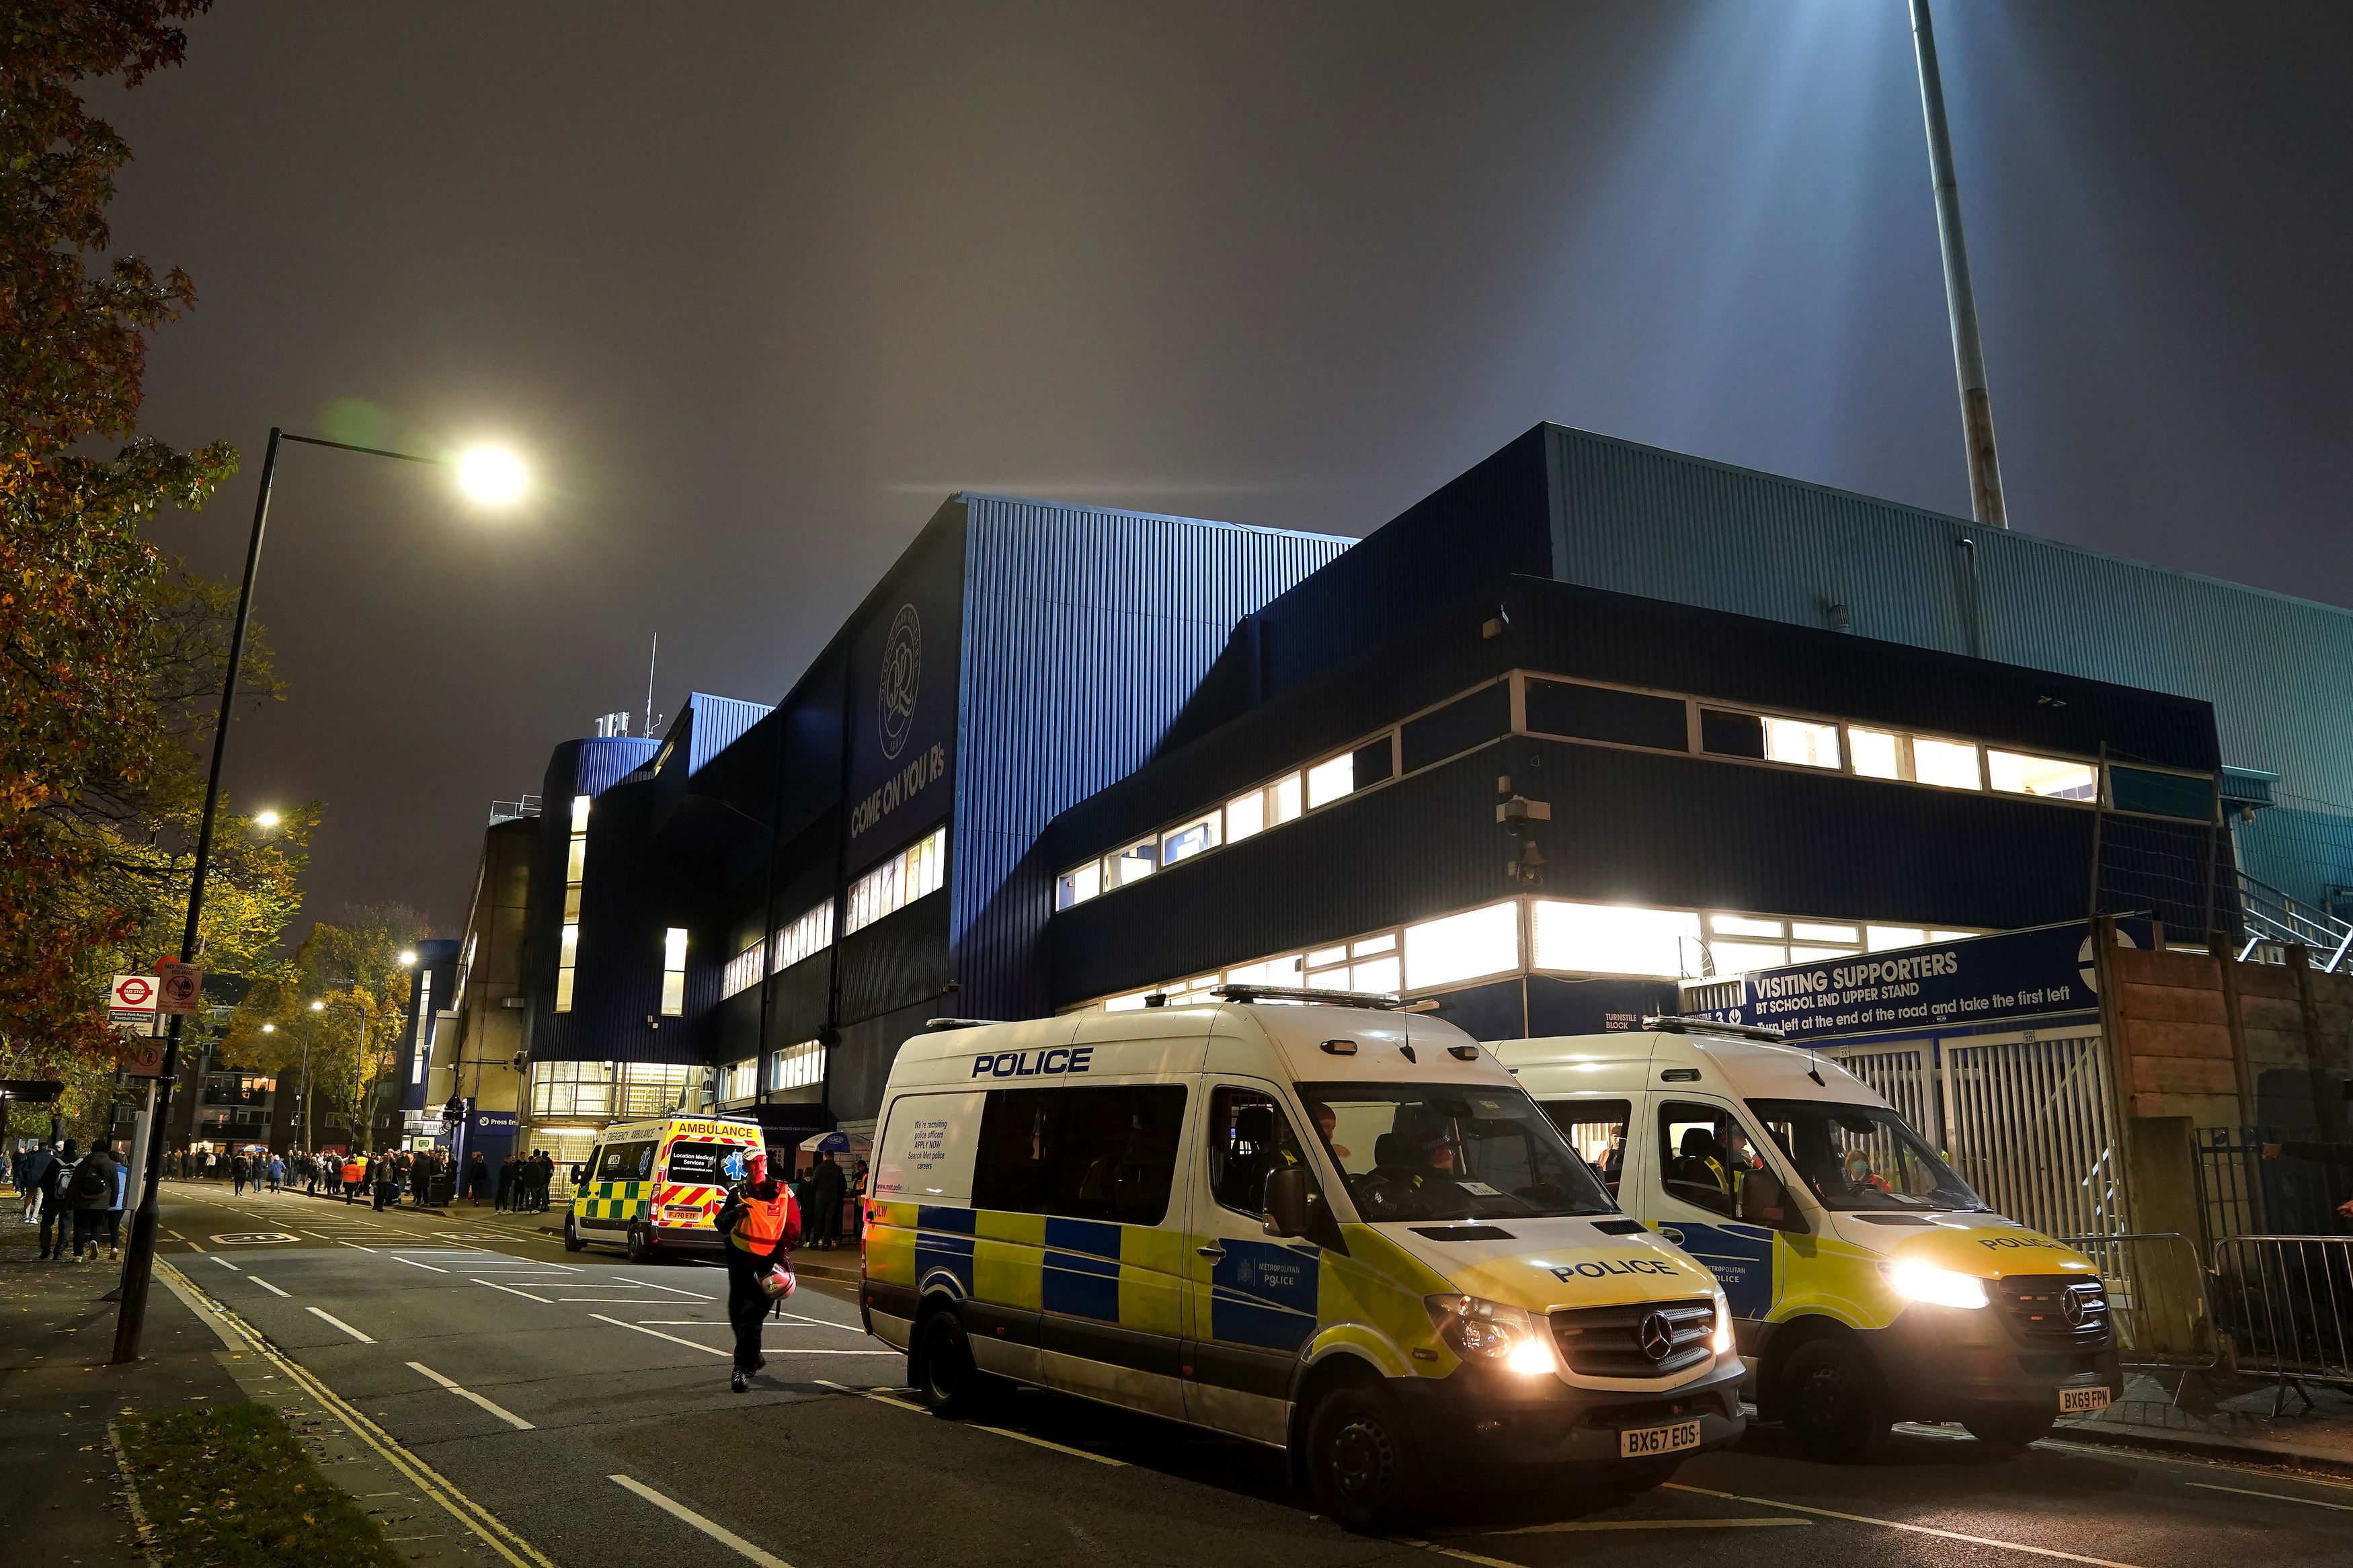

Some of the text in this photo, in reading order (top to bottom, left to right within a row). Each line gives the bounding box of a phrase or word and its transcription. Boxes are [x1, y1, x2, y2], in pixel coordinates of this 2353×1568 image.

[851, 787, 881, 839] COME
[883, 772, 901, 815] ON
[903, 751, 927, 801] YOU
[1754, 951, 1958, 999] VISITING SUPPORTERS
[1755, 982, 1919, 1015] BT SCHOOL END UPPER STAND
[1782, 1018, 1799, 1031] left
[1801, 1017, 1814, 1030] at
[1815, 1015, 1833, 1028] the
[1836, 1011, 1858, 1026] end
[1861, 1009, 1874, 1022] of
[1875, 1007, 1895, 1021] the
[1898, 1003, 1927, 1019] road
[1931, 999, 1957, 1014] and
[1959, 997, 1989, 1012] take
[1992, 994, 2015, 1008] the
[2018, 989, 2043, 1005] first
[2046, 986, 2070, 1002] left
[1605, 1013, 1637, 1022] TURNSTILE
[1684, 1011, 1724, 1024] NSTILE 3
[1606, 1021, 1628, 1030] BLOCK
[971, 1047, 1094, 1078] POLICE
[678, 1123, 753, 1137] AMBULANCE
[914, 1120, 947, 1130] We're recruiting
[606, 1128, 655, 1141] EMERGENCY AMBULANCE
[914, 1130, 926, 1141] police
[914, 1141, 942, 1149] APPLY NOW
[908, 1151, 945, 1161] Search Met police
[1977, 1237, 2067, 1250] POLICE
[1259, 1263, 1300, 1274] METROPOLITAN
[1548, 1260, 1679, 1283] POLICE
[1264, 1274, 1293, 1285] POLICE
[1715, 1274, 1740, 1282] OLICE
[2065, 1390, 2108, 1409] BX69 FPN
[1629, 1424, 1696, 1452] BX67 EOS
